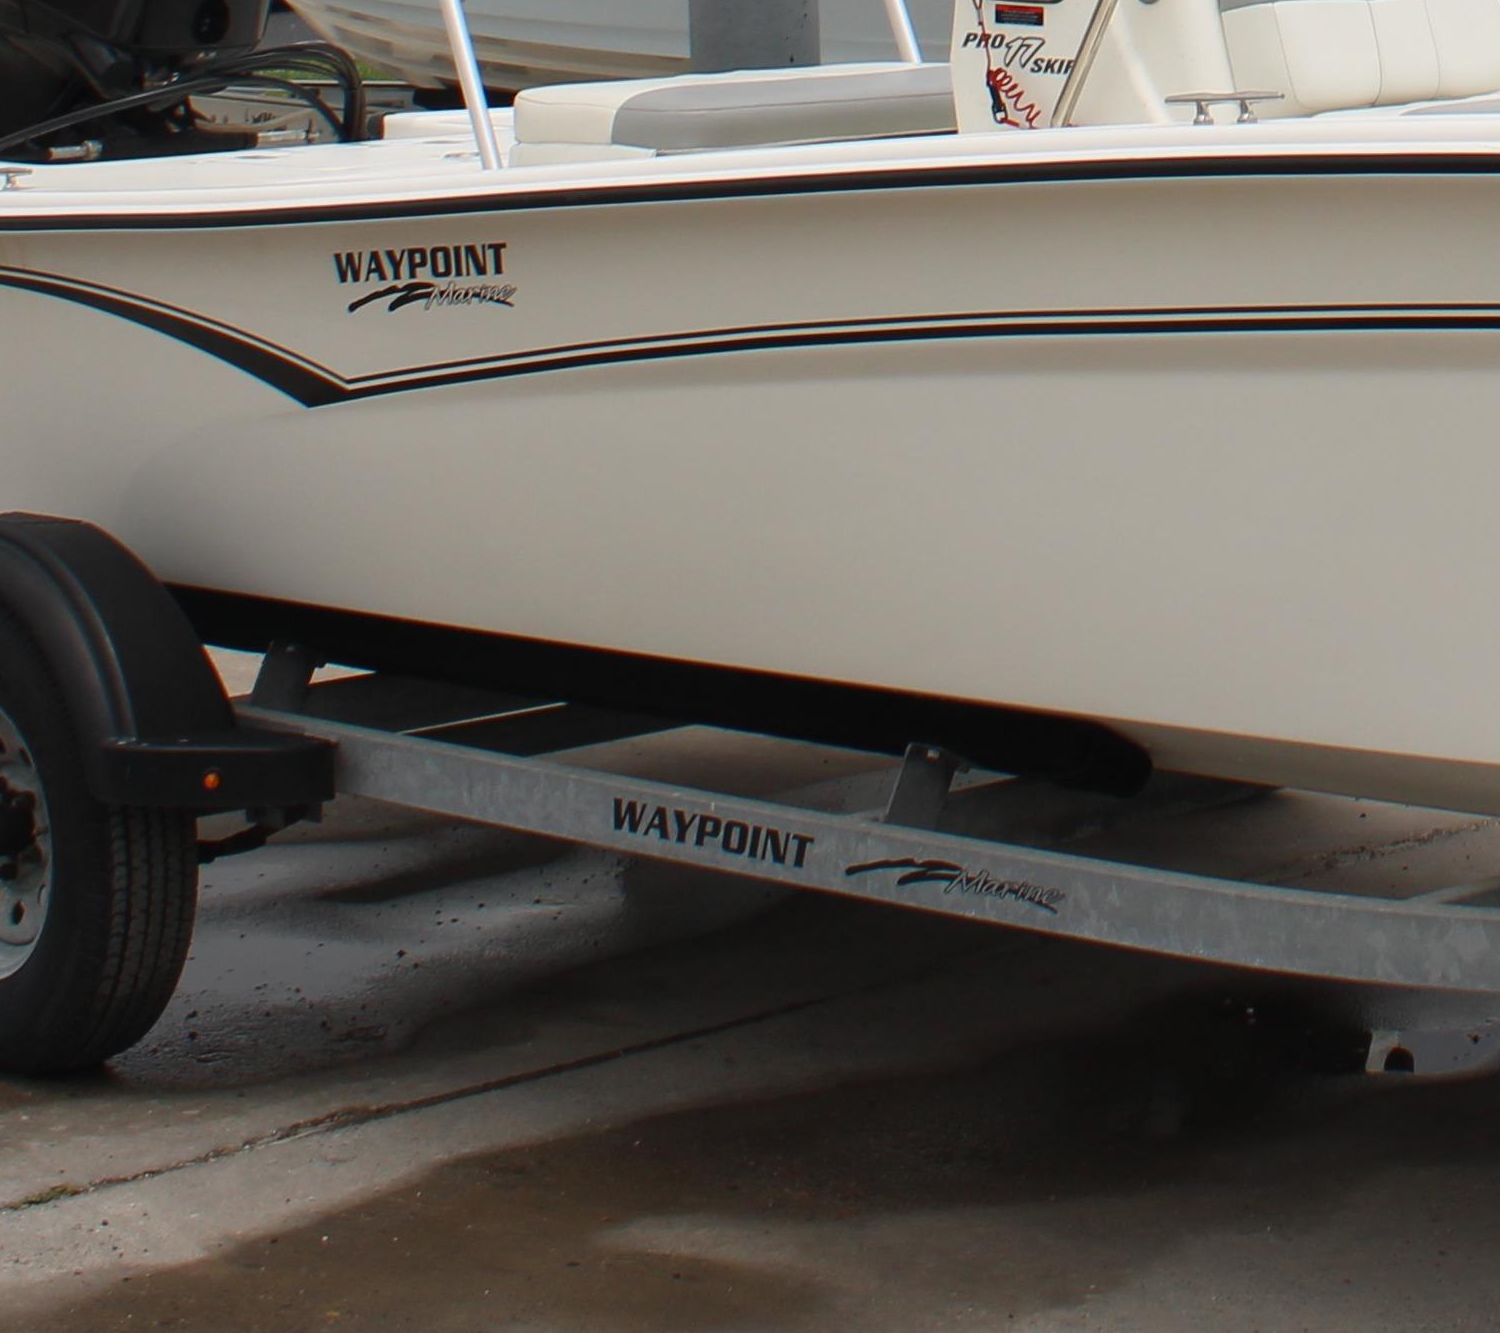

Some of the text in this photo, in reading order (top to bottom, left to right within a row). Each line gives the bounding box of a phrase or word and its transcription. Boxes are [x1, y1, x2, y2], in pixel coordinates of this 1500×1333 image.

[962, 33, 1006, 49] PRO
[1004, 36, 1046, 69] 17
[334, 242, 507, 283] WAYPOINT
[425, 281, 516, 311] Marine
[612, 797, 814, 869] WAYPOINT
[944, 869, 1065, 911] Marine
